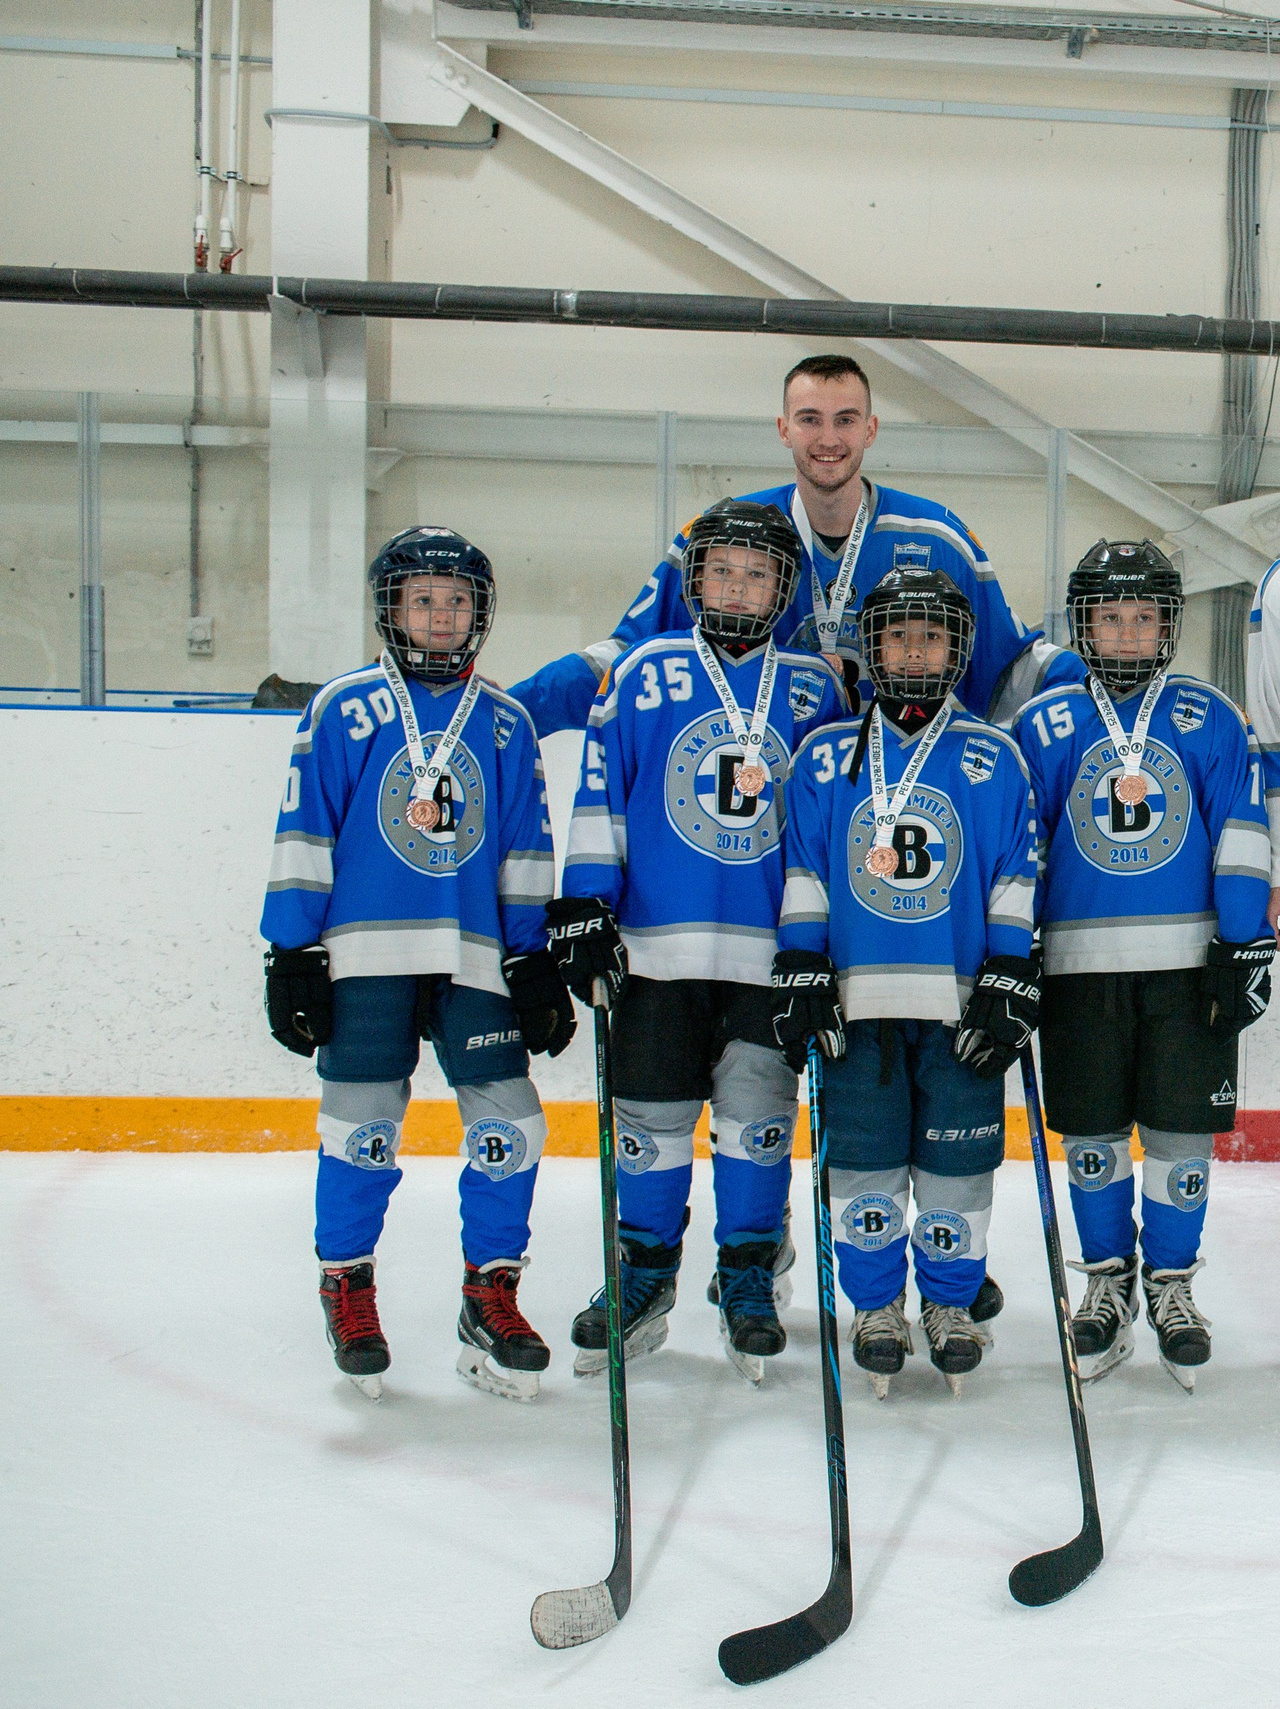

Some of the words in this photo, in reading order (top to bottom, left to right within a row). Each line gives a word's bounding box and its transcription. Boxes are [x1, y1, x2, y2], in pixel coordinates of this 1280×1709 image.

[425, 550, 461, 559] CCM
[835, 544, 859, 602] РЕГИОНАЛЬНЫЙ
[635, 656, 694, 712] 35
[706, 660, 724, 683] СЕЗОН
[718, 682, 738, 714] 2024/25
[757, 658, 775, 713] РЕГИОНАЛЬНЫЙ
[340, 687, 397, 742] 30
[403, 708, 418, 744] 2024/25
[442, 697, 472, 749] РЕГИОНАЛЬНЫЙ
[1031, 699, 1076, 749] 15
[1100, 700, 1118, 727] 2024/25
[682, 732, 709, 760] ХК
[872, 741, 882, 763] СЕЗОН
[584, 740, 608, 792] 5
[873, 764, 884, 795] 2024/25
[899, 741, 931, 796] РЕГИОНАЛЬНЫЙ
[1079, 760, 1102, 785] ХК
[281, 766, 301, 815] 0
[716, 832, 752, 852] 2014
[891, 823, 932, 880] В
[1109, 847, 1150, 865] 2014
[891, 895, 928, 912] 2014
[547, 917, 604, 940] AUER
[772, 972, 831, 988] AUER
[466, 1030, 524, 1050] BAUE
[925, 1123, 1001, 1142] BAUER
[485, 1136, 506, 1163] В
[1083, 1152, 1101, 1175] В
[864, 1211, 884, 1233] В
[863, 1238, 883, 1246] 2014
